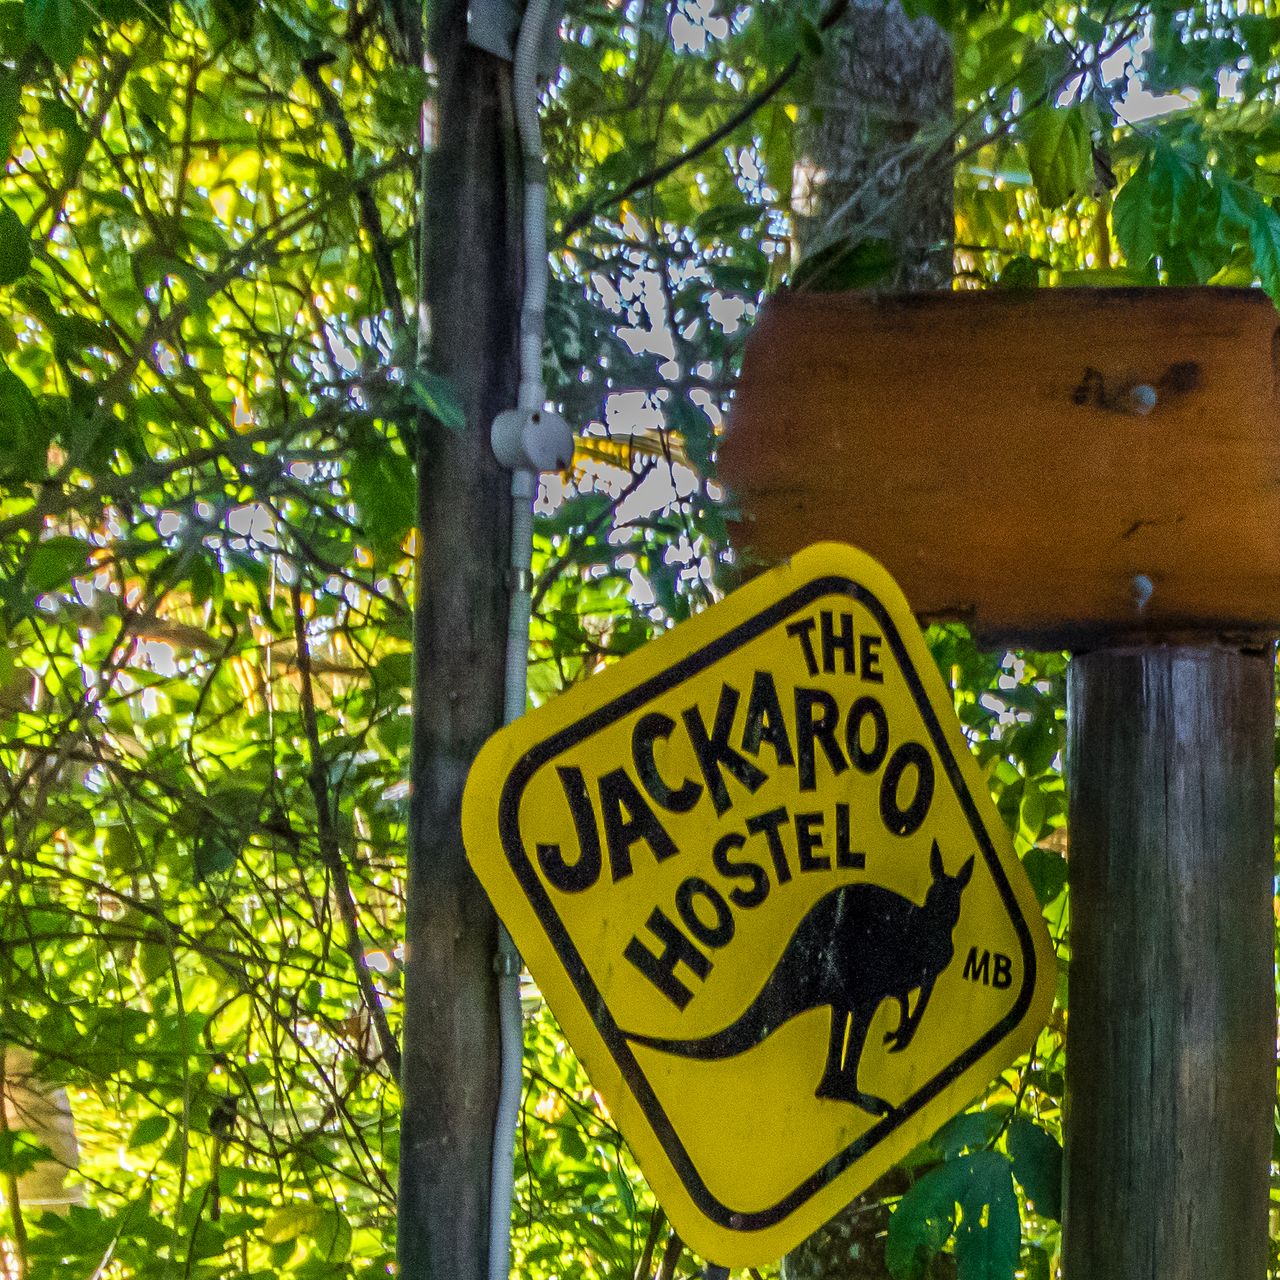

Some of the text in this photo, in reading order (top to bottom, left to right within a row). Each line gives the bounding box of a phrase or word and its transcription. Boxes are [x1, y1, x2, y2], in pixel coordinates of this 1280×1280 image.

[787, 610, 884, 683] THE
[536, 670, 934, 893] JACKAROO
[623, 803, 866, 1010] HOSTEL
[961, 946, 1012, 989] MB
